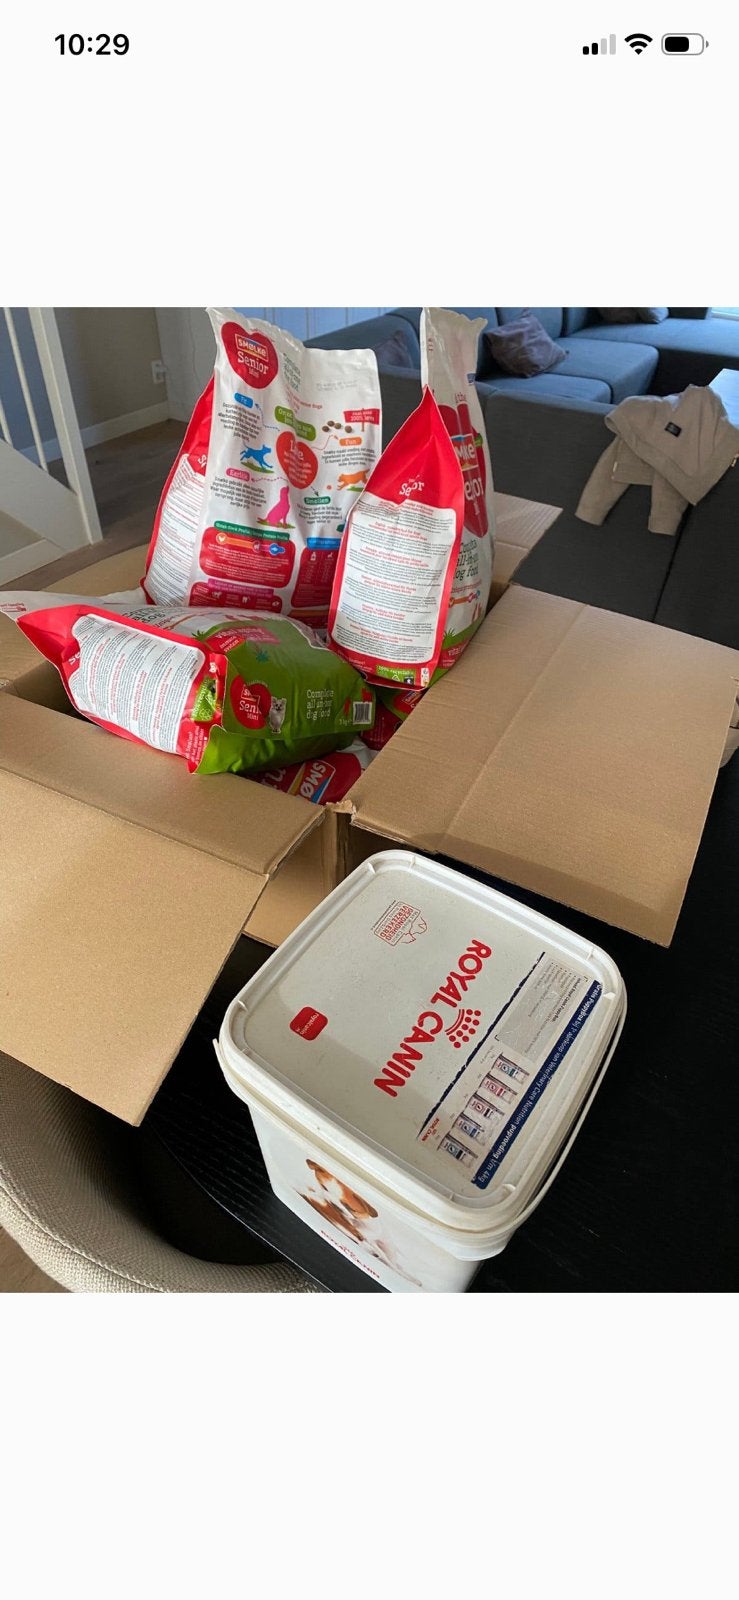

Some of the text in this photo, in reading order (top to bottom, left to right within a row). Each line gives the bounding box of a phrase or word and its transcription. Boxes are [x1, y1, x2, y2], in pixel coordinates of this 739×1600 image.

[237, 350, 269, 375] Senior
[300, 762, 326, 798] SMØ
[380, 904, 408, 938] VERZEKERD
[430, 939, 492, 1008] ROYAL
[374, 1011, 443, 1098] CANIN
[552, 1052, 561, 1062] van
[535, 1060, 556, 1088] Veterinary
[529, 1086, 541, 1101] Care
[514, 1100, 533, 1126] Nutrition
[492, 1123, 517, 1159] pupvoeding
[477, 1169, 490, 1183] 4kg
